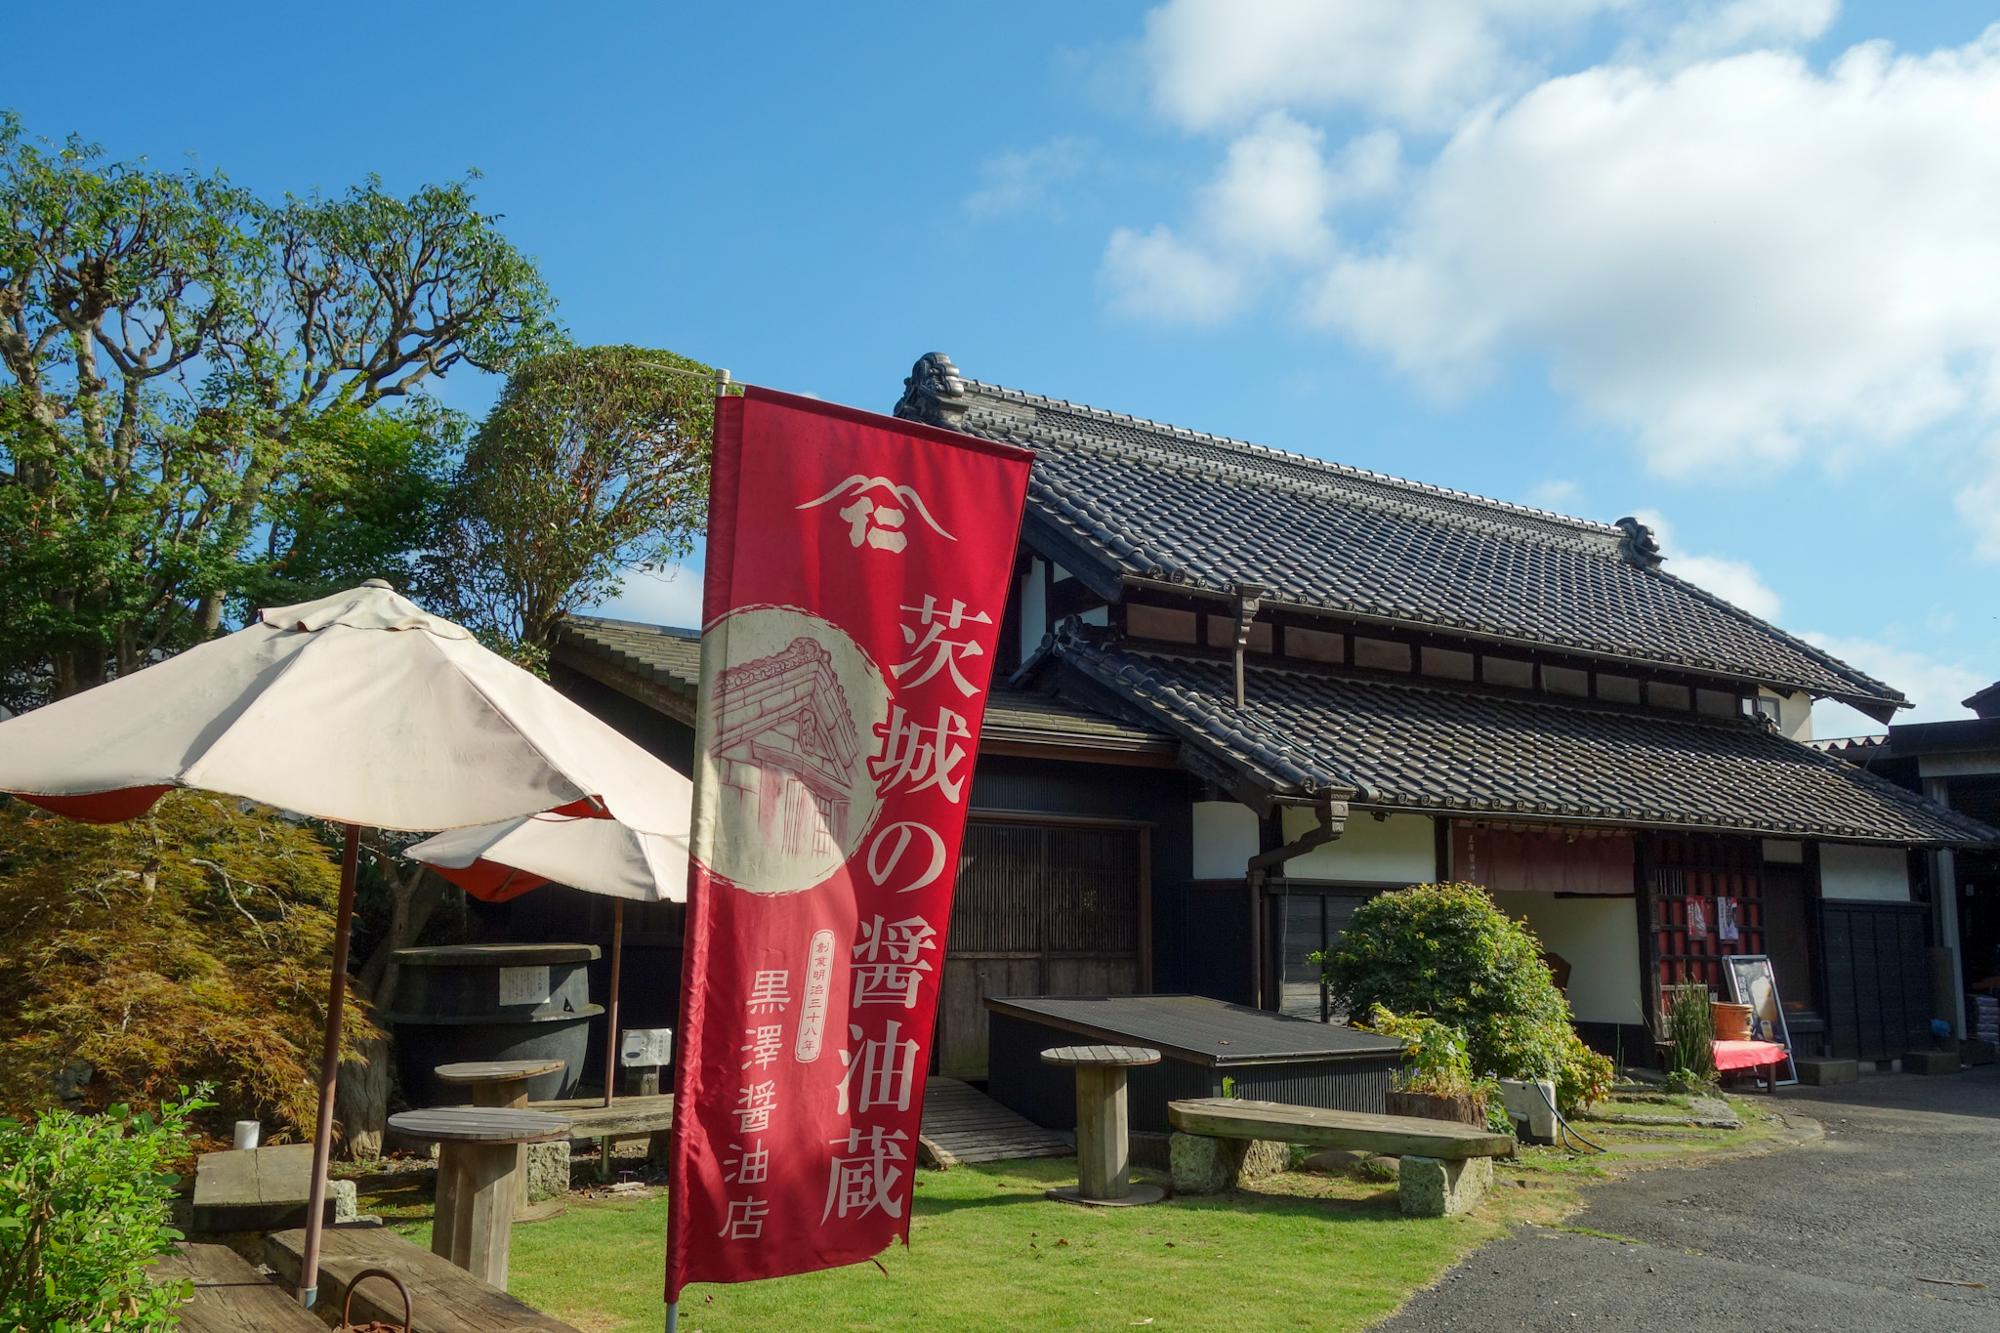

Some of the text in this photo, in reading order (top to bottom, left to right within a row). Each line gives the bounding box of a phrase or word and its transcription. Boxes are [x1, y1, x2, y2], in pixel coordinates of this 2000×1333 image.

[802, 942, 830, 1051] 創業明治三十八年
[821, 594, 992, 1226] 茨城の醤油蔵
[718, 970, 791, 1240] 黒澤醤油店
